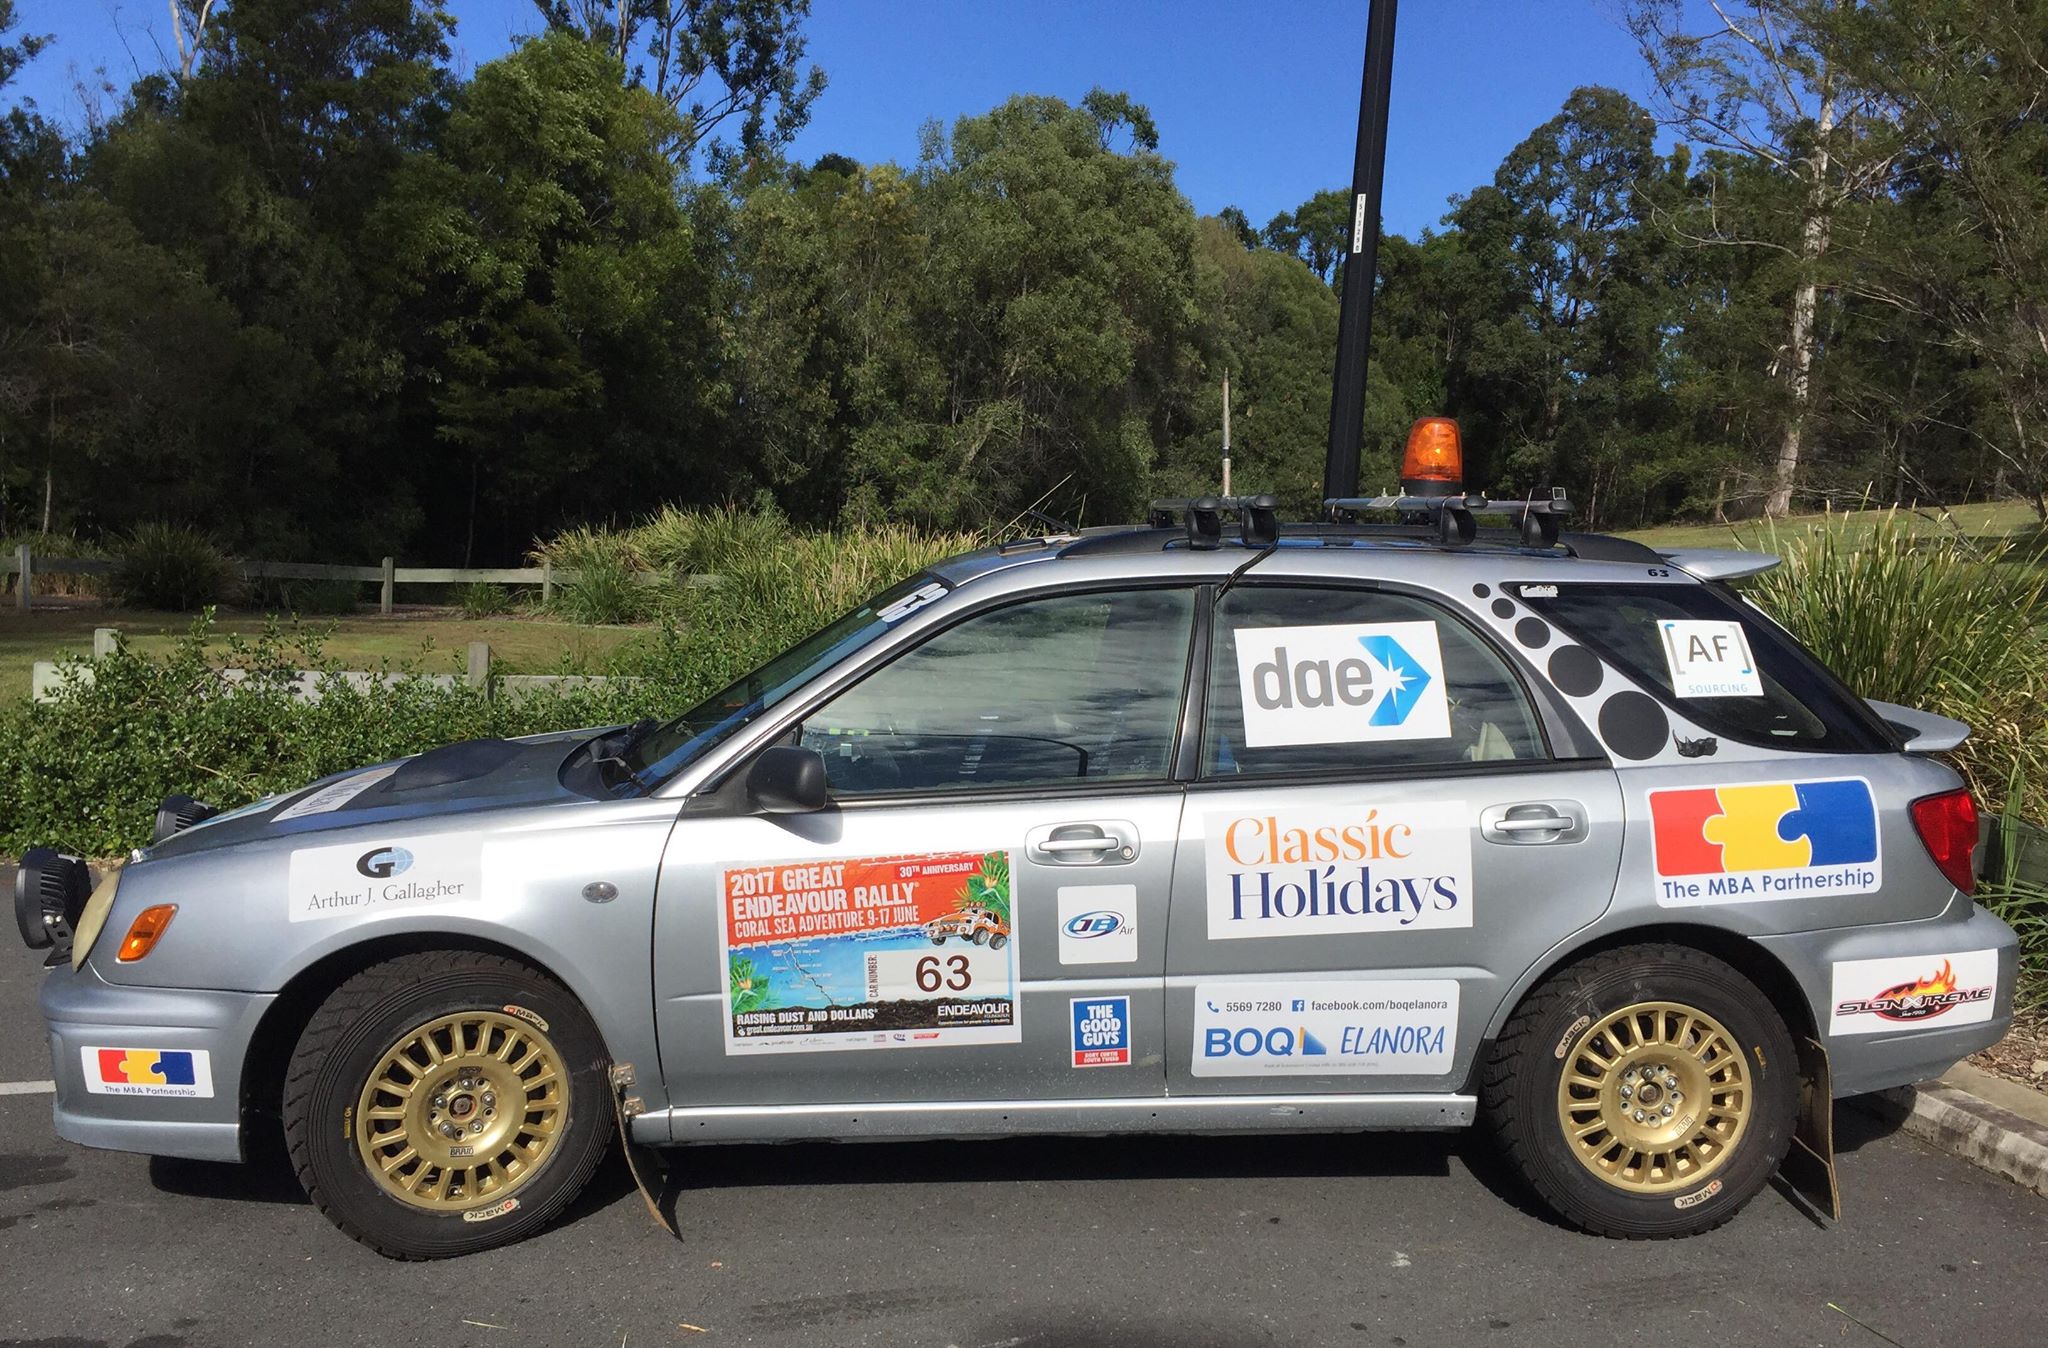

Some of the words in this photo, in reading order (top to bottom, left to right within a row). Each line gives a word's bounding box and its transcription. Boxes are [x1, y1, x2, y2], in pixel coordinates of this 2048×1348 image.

[1647, 569, 1669, 578] 63
[1253, 647, 1374, 710] dae
[1688, 684, 1749, 694] SOURCING
[1225, 809, 1413, 866] Classic
[922, 862, 974, 875] ANNIVERSARY
[730, 871, 775, 896] 2017
[782, 865, 845, 891] GREAT
[1663, 881, 1700, 898] The
[1708, 877, 1755, 896] MBA
[1763, 868, 1874, 892] Partnership
[308, 891, 361, 910] Arthur
[364, 888, 376, 906] J.
[383, 880, 464, 901] Gallagher
[1227, 865, 1458, 925] Holidays
[733, 889, 848, 920] ENDEAVOUR
[735, 920, 772, 938] CORAL
[774, 918, 796, 934] SEA
[799, 911, 864, 932] ADVENTURE
[867, 907, 890, 925] 9-17
[893, 905, 920, 923] JUNE
[1119, 926, 1135, 935] Air
[915, 955, 972, 992] 63
[868, 985, 879, 998] CAR
[937, 1003, 1010, 1016] ENDEAVOUR
[1087, 1005, 1114, 1019] THE
[1226, 1002, 1253, 1012] 5569
[1256, 1001, 1282, 1012] 7280
[1311, 1000, 1448, 1012] facebook.com/boqelanora
[737, 1012, 776, 1025] RAISING
[779, 1011, 805, 1023] DUST
[808, 1010, 828, 1022] AND
[1080, 1018, 1121, 1033] GOOD
[1205, 1027, 1294, 1057] BOQ
[1341, 1026, 1445, 1055] ELANORA
[123, 1086, 143, 1094] MBA
[147, 1088, 196, 1096] Partnership
